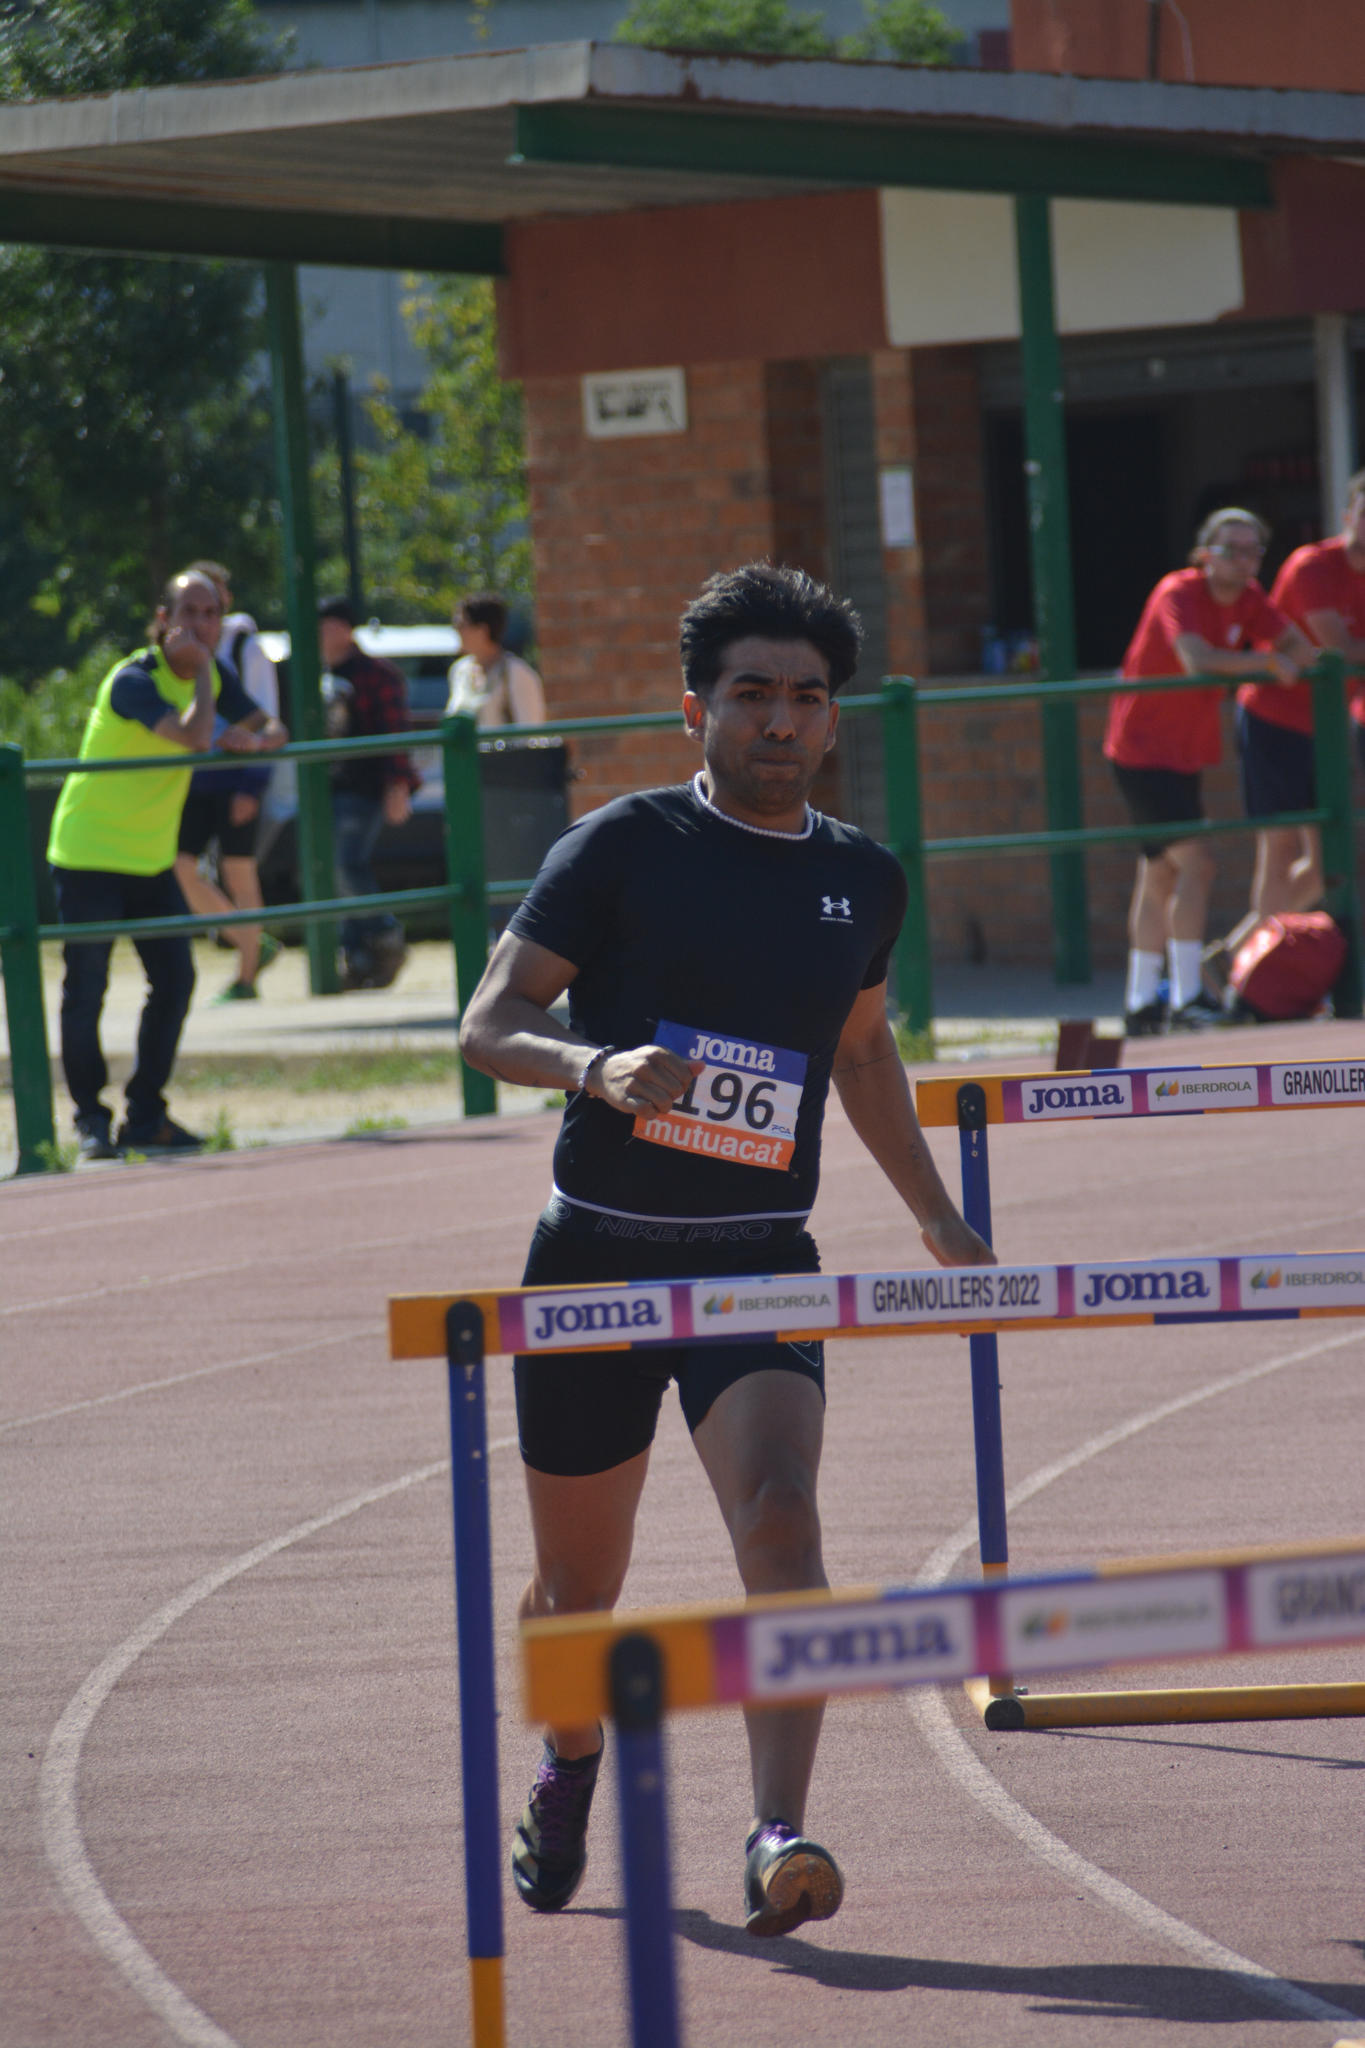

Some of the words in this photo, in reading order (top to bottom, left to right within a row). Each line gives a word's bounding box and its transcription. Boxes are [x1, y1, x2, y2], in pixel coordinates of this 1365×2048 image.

[689, 1034, 776, 1072] Joma
[671, 1072, 777, 1130] 196
[1029, 1083, 1124, 1114] Joma
[1181, 1080, 1252, 1096] IBERDROLA
[644, 1118, 783, 1165] mutuacat
[595, 1215, 684, 1242] NIKE
[686, 1220, 772, 1242] PRO
[738, 1294, 830, 1312] IBERDROLA
[873, 1277, 993, 1315] GRANOLLERS
[998, 1274, 1041, 1308] 2022
[1083, 1268, 1210, 1308] Joma
[534, 1298, 662, 1340] Joma
[766, 1614, 955, 1681] Joma
